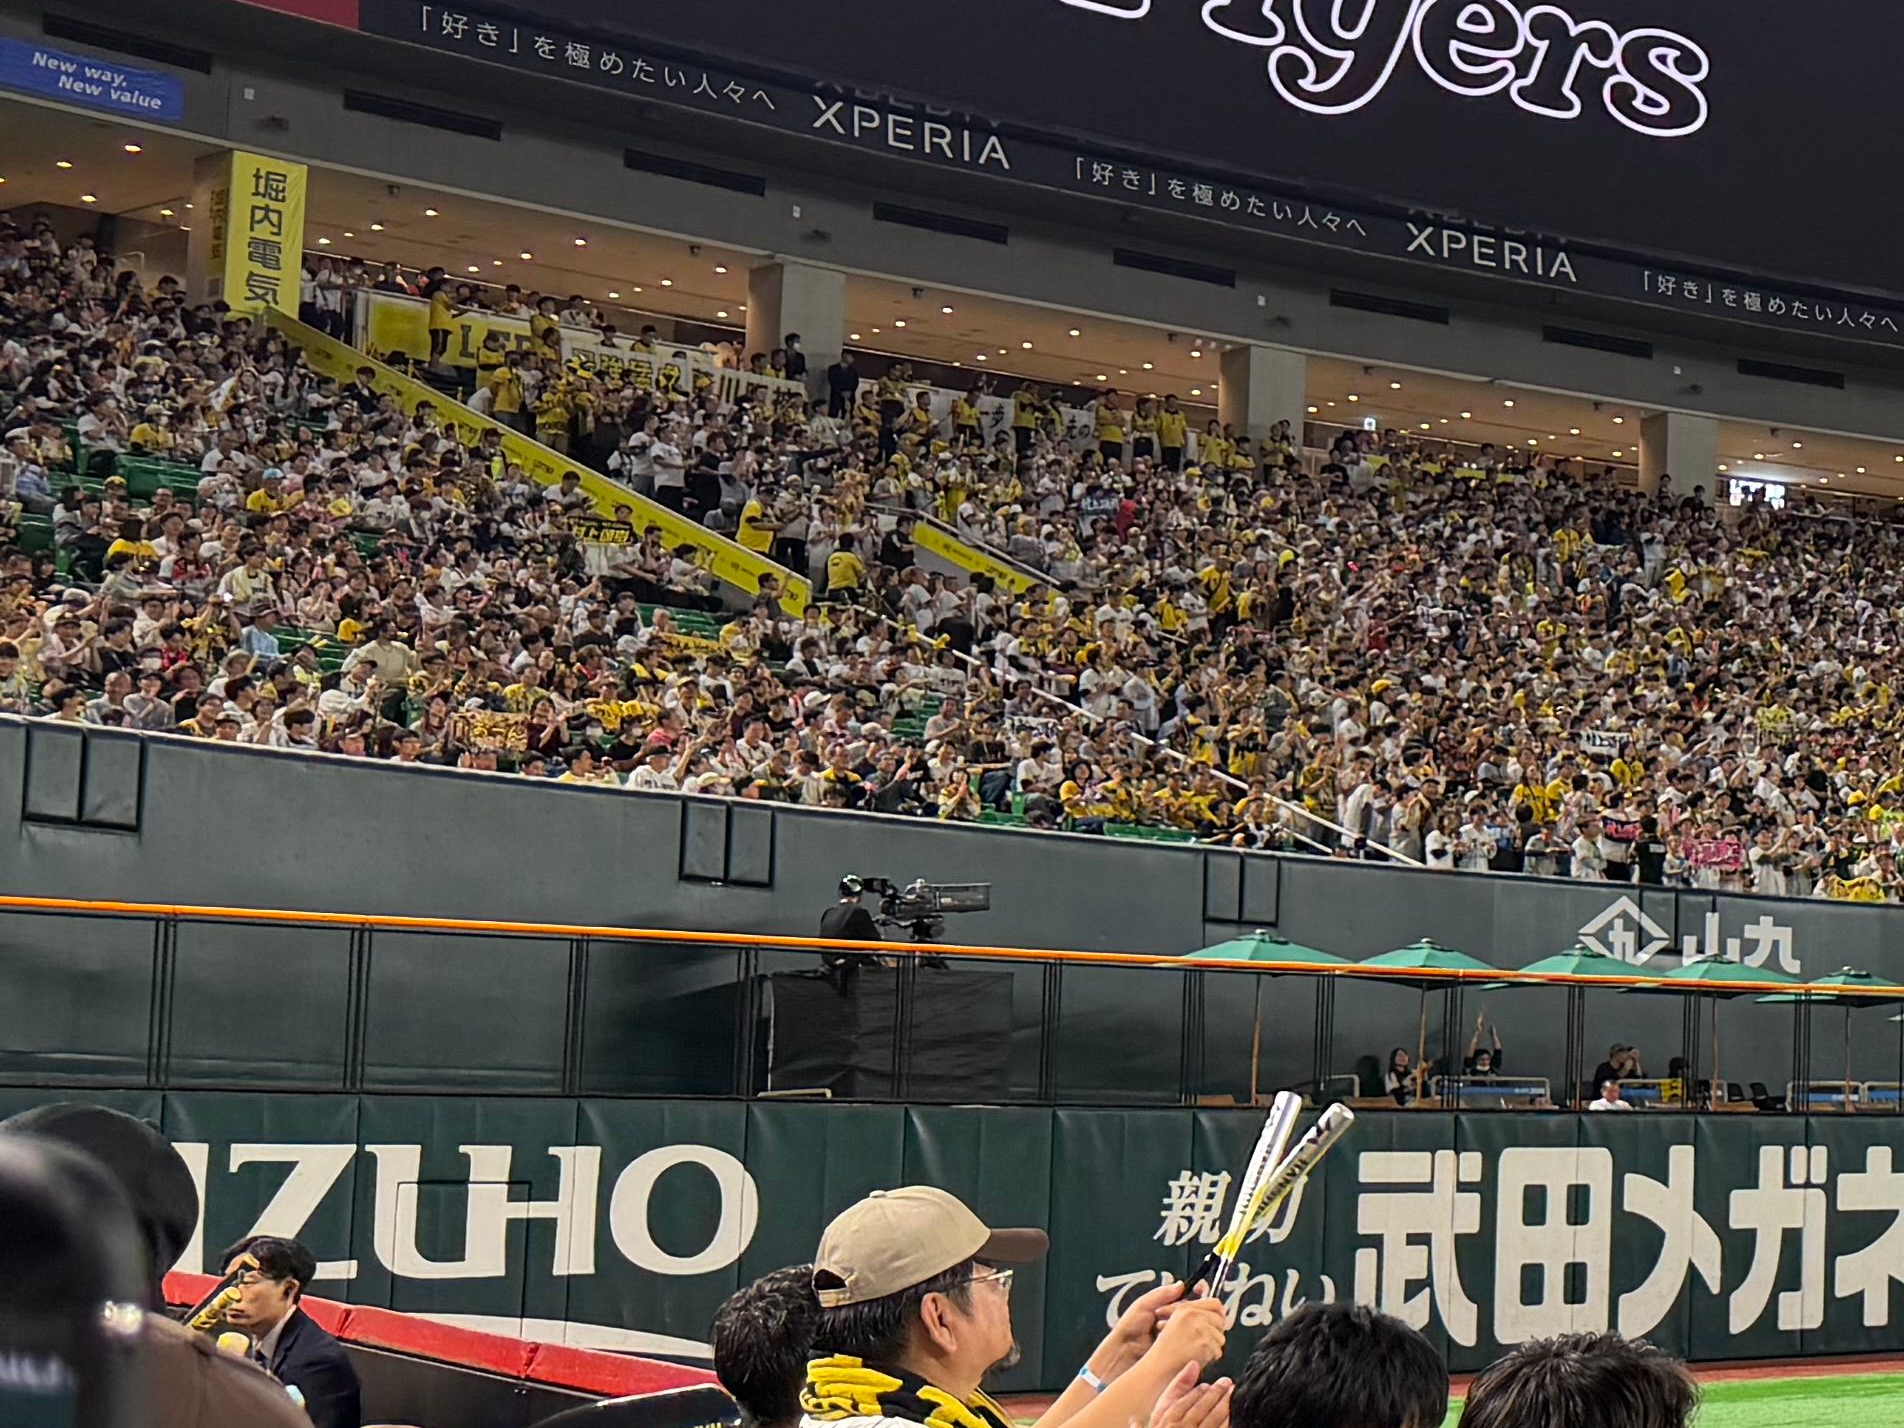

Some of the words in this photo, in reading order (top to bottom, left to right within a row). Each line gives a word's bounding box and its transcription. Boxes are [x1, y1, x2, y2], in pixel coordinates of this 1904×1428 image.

[32, 50, 78, 73] New
[84, 61, 129, 89] way,
[57, 74, 104, 98] New
[108, 85, 163, 112] value
[812, 95, 1011, 170] XPERIA
[1406, 222, 1577, 283] XPERIA
[244, 167, 289, 308] 堀内電気
[1683, 912, 1801, 974] 山九
